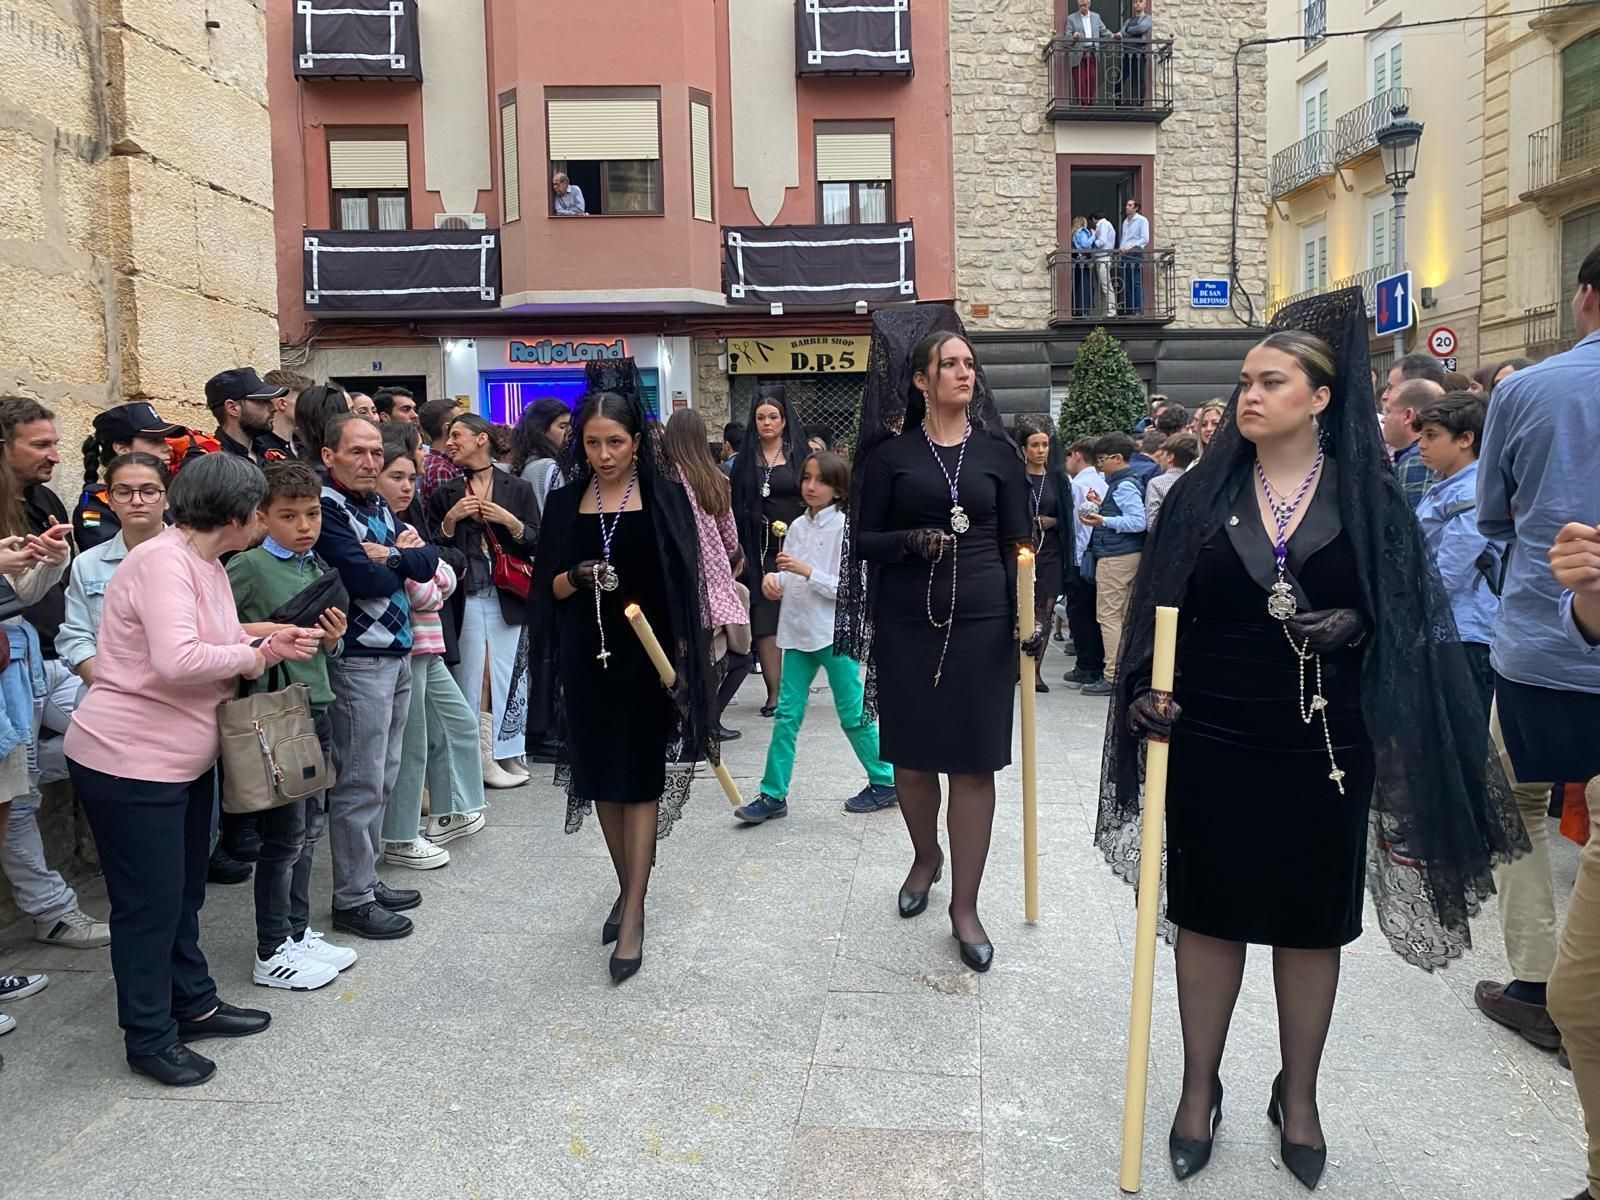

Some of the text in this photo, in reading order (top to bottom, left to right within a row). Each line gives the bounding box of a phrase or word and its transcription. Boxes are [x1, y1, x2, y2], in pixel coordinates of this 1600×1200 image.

[790, 337, 854, 349] BARBER SHOP
[1436, 337, 1451, 347] 20
[790, 351, 855, 371] D.P.5
